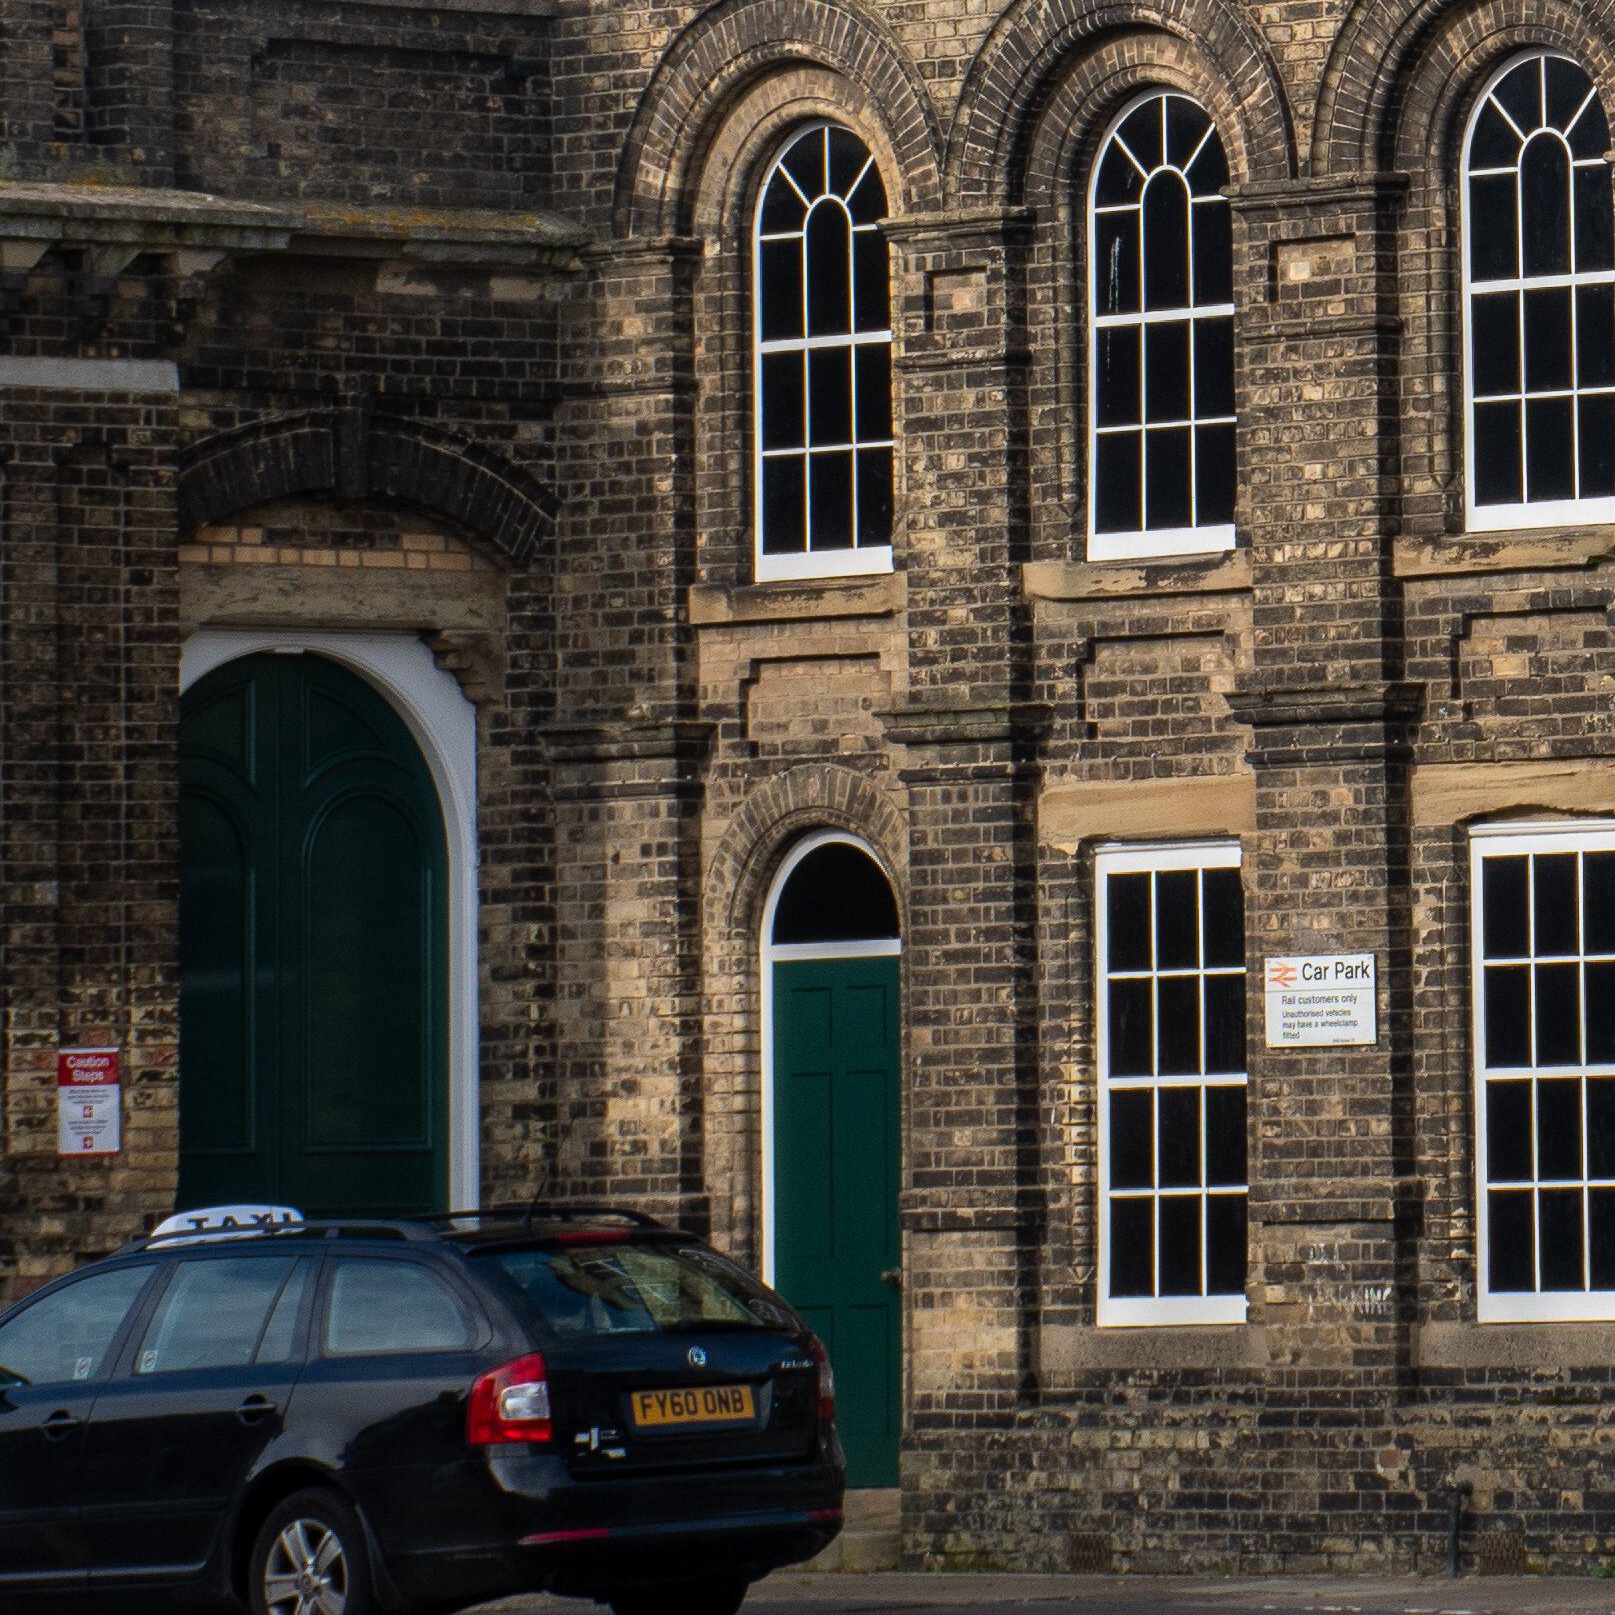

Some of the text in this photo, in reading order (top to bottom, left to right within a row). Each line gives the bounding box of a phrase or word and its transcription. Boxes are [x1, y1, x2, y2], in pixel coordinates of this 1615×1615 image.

[1302, 960, 1370, 981] Car Park
[1281, 993, 1358, 1005] Rail customers only
[1282, 1007, 1352, 1018] Unauthorised vehicles
[1282, 1021, 1296, 1030] may
[1297, 1019, 1313, 1028] have
[66, 1055, 110, 1068] Caution
[72, 1069, 104, 1083] Steps
[640, 1387, 745, 1420] FY60 ONB
